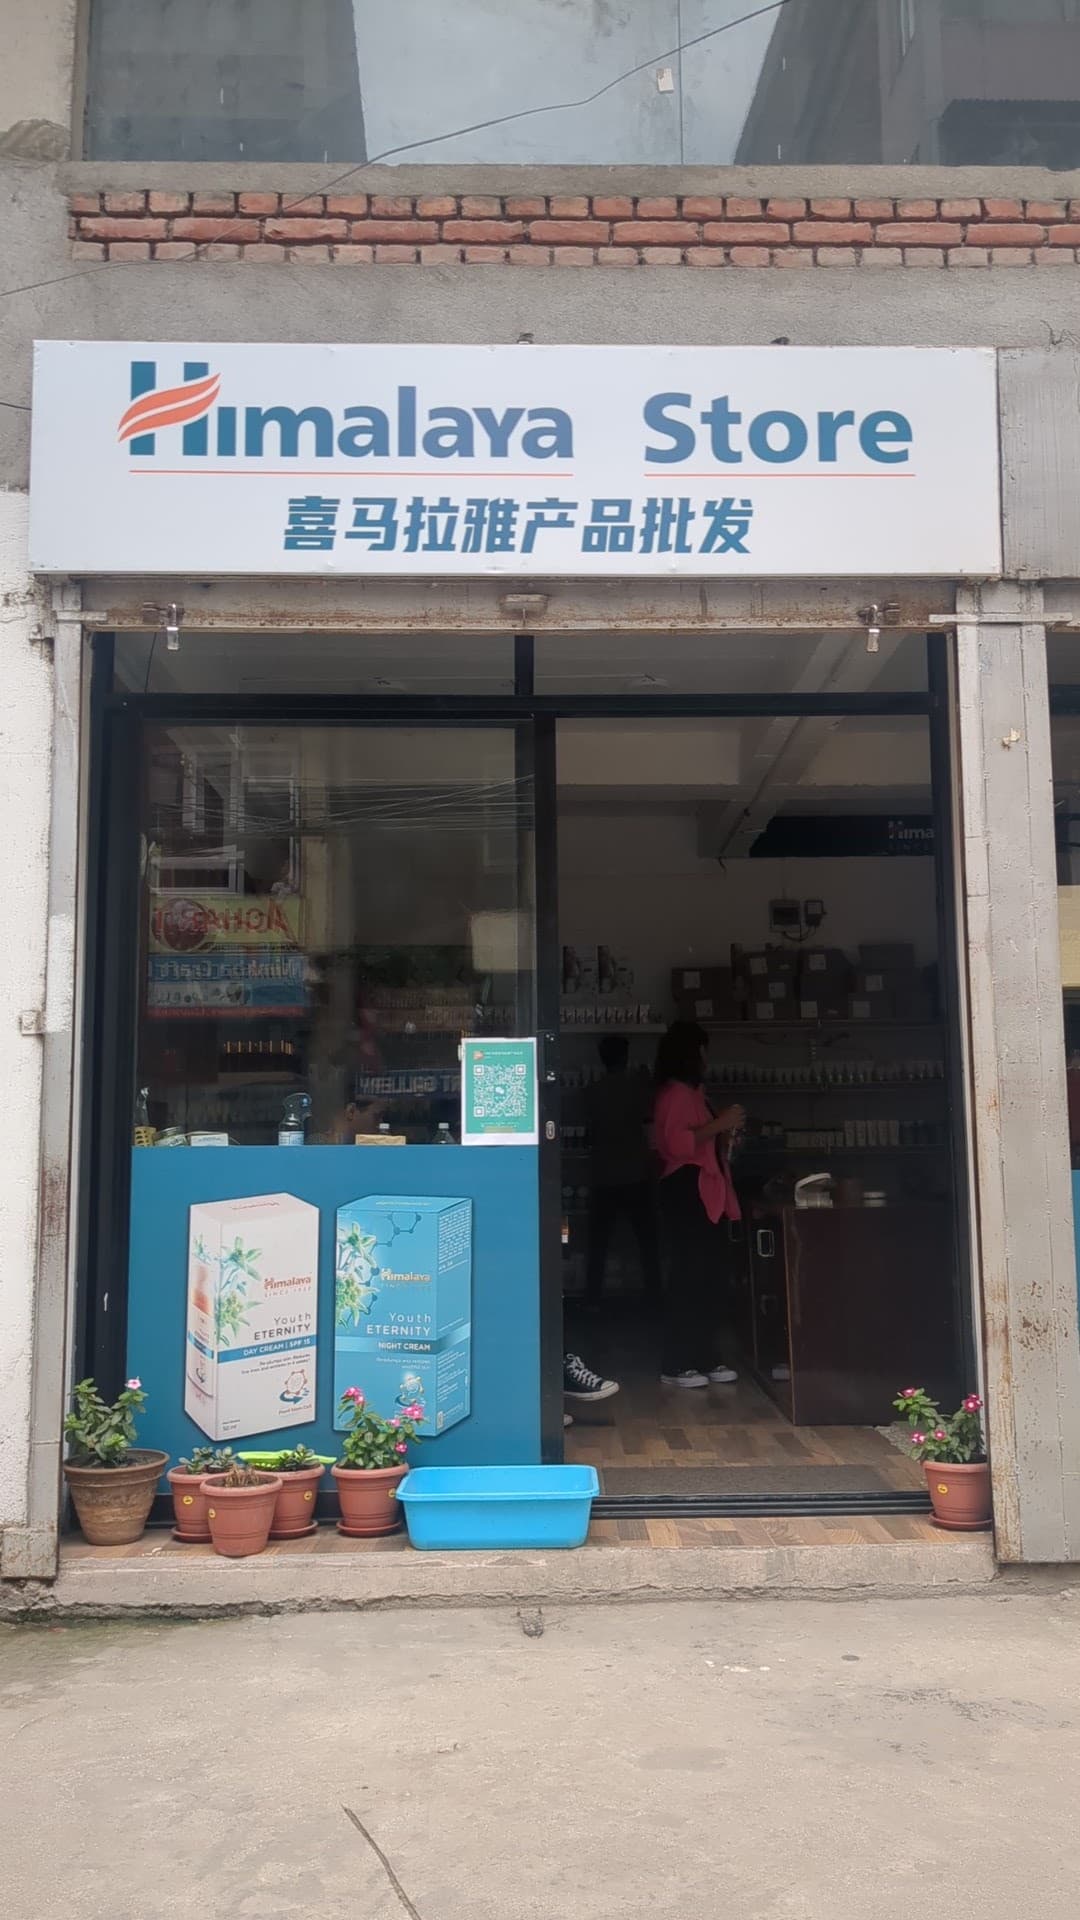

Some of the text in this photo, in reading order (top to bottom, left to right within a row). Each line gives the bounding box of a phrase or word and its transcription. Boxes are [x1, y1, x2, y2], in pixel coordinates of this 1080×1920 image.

[118, 361, 913, 464] Himalaya Store
[284, 496, 753, 554] 喜马拉雅产品批发
[381, 1268, 432, 1282] Himalaya
[264, 1276, 311, 1290] Himalaya
[274, 1312, 311, 1325] Youth
[389, 1312, 431, 1323] Youth
[254, 1323, 311, 1341] ETERNITY
[367, 1324, 431, 1337] ETERNITY
[243, 1347, 258, 1356] DAY
[259, 1343, 284, 1353] CREAM
[289, 1340, 302, 1348] SPF
[378, 1342, 431, 1351] NIGHT CREAM
